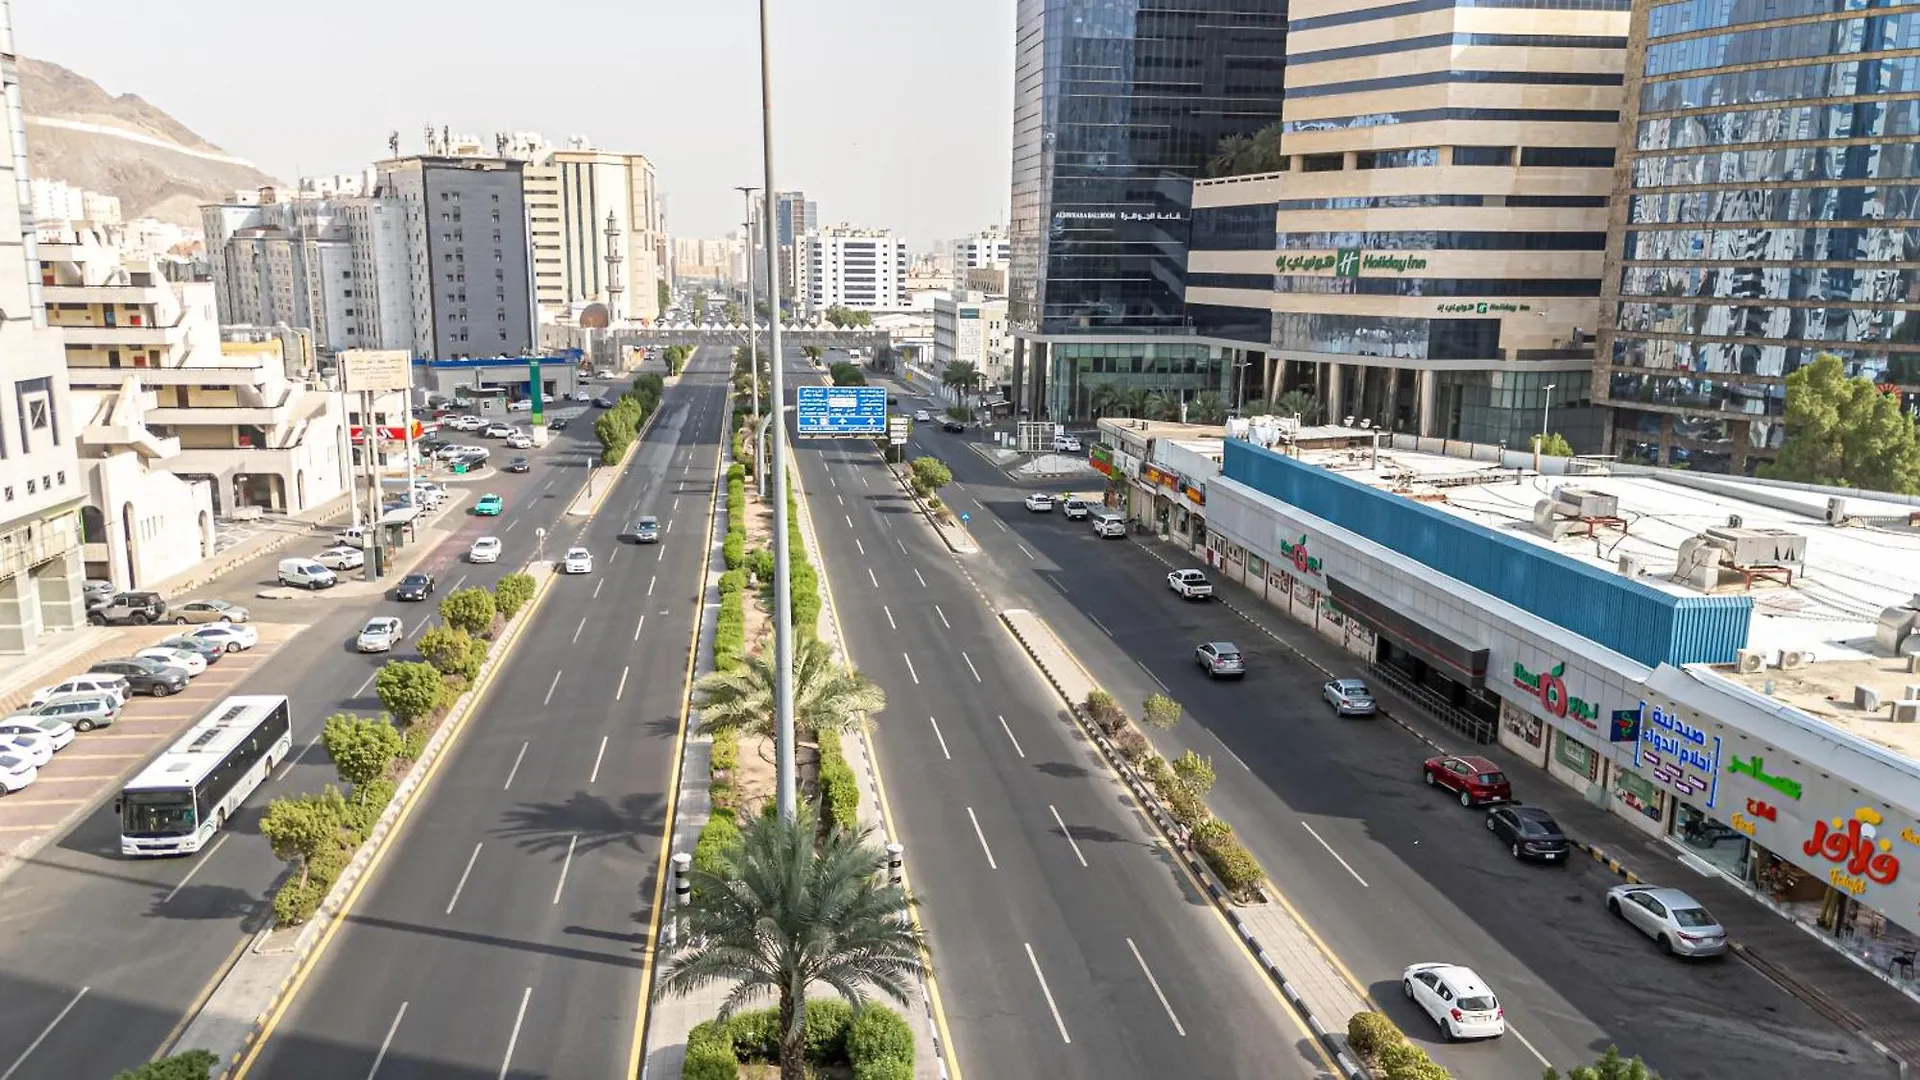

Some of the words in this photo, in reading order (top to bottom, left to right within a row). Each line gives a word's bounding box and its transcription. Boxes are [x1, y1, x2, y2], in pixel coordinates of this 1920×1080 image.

[1362, 254, 1406, 272] Holiday
[1407, 254, 1427, 270] Inn
[1652, 706, 1706, 746] صيدلية
[1643, 728, 1680, 757] الدواء
[1678, 748, 1713, 773] أحلام
